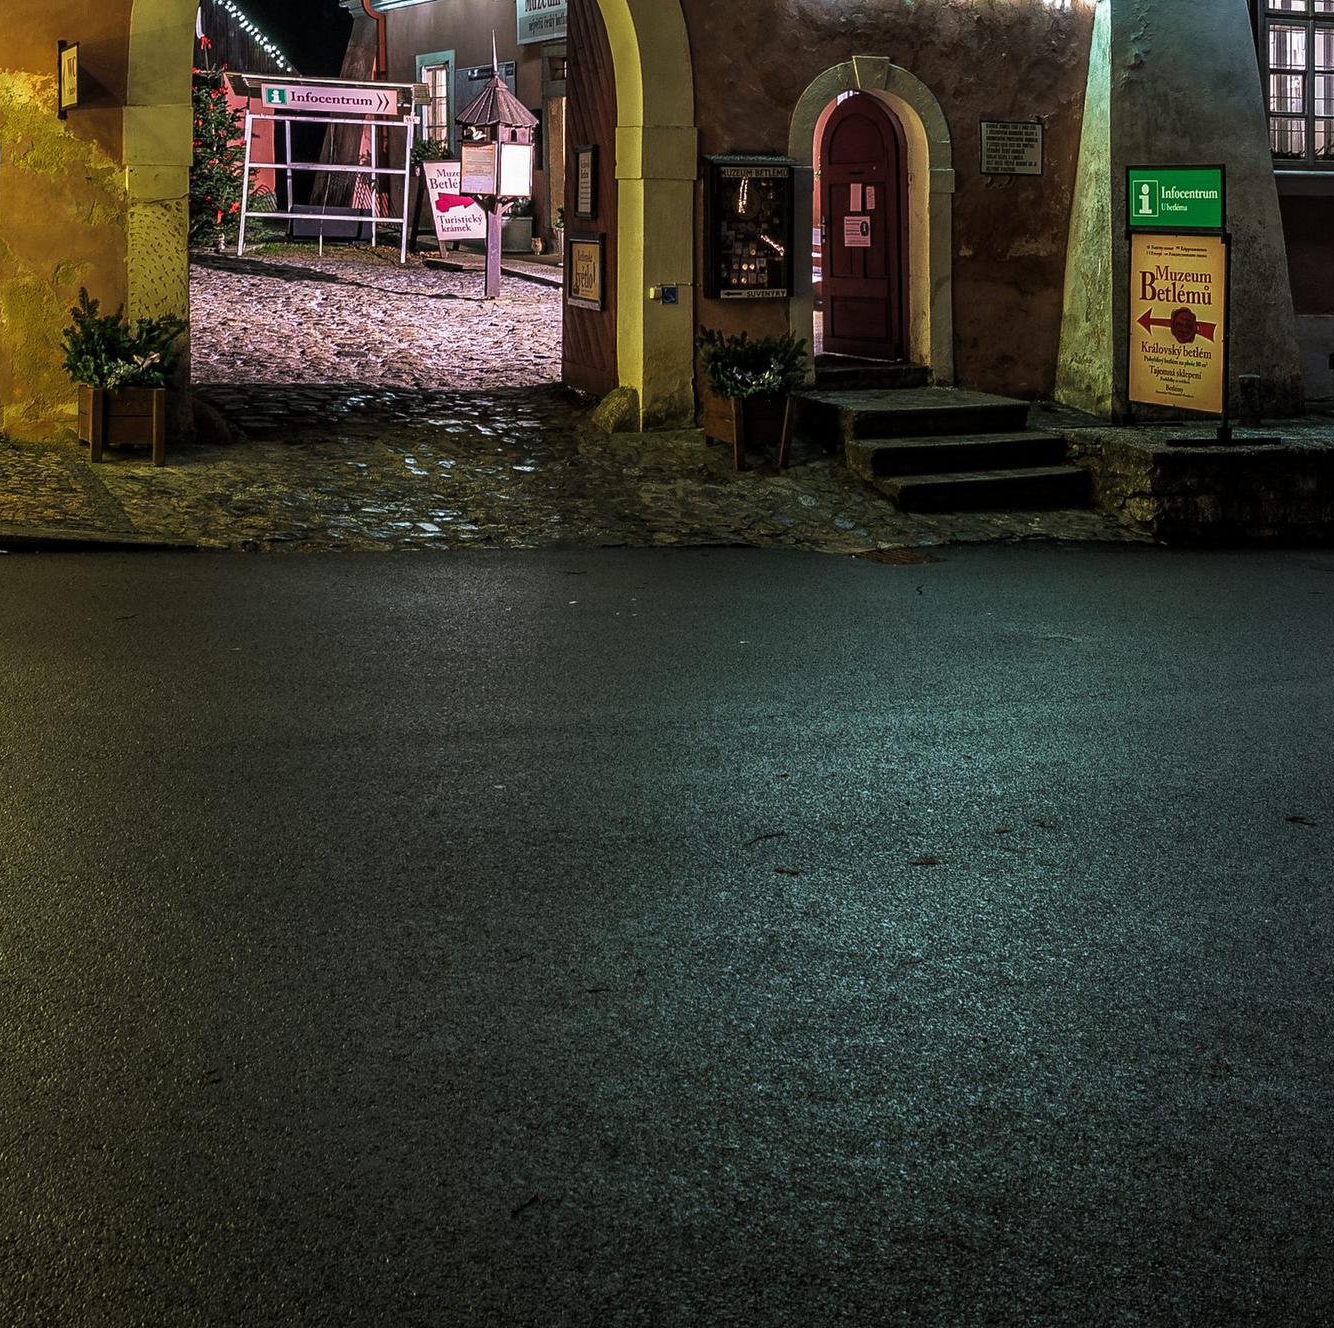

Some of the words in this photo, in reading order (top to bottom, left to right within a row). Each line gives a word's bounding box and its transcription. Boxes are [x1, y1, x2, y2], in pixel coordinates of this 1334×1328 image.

[290, 91, 373, 106] Infocentrum
[436, 168, 460, 178] Muze
[428, 177, 460, 189] Betlé
[1161, 185, 1219, 199] Infocentrum
[436, 214, 483, 225] Turistický
[441, 224, 472, 233] krámek
[1155, 265, 1212, 283] Muzeum
[1139, 271, 1212, 305] Betlémů
[1141, 341, 1182, 359] Královský
[1183, 345, 1212, 359] betlém
